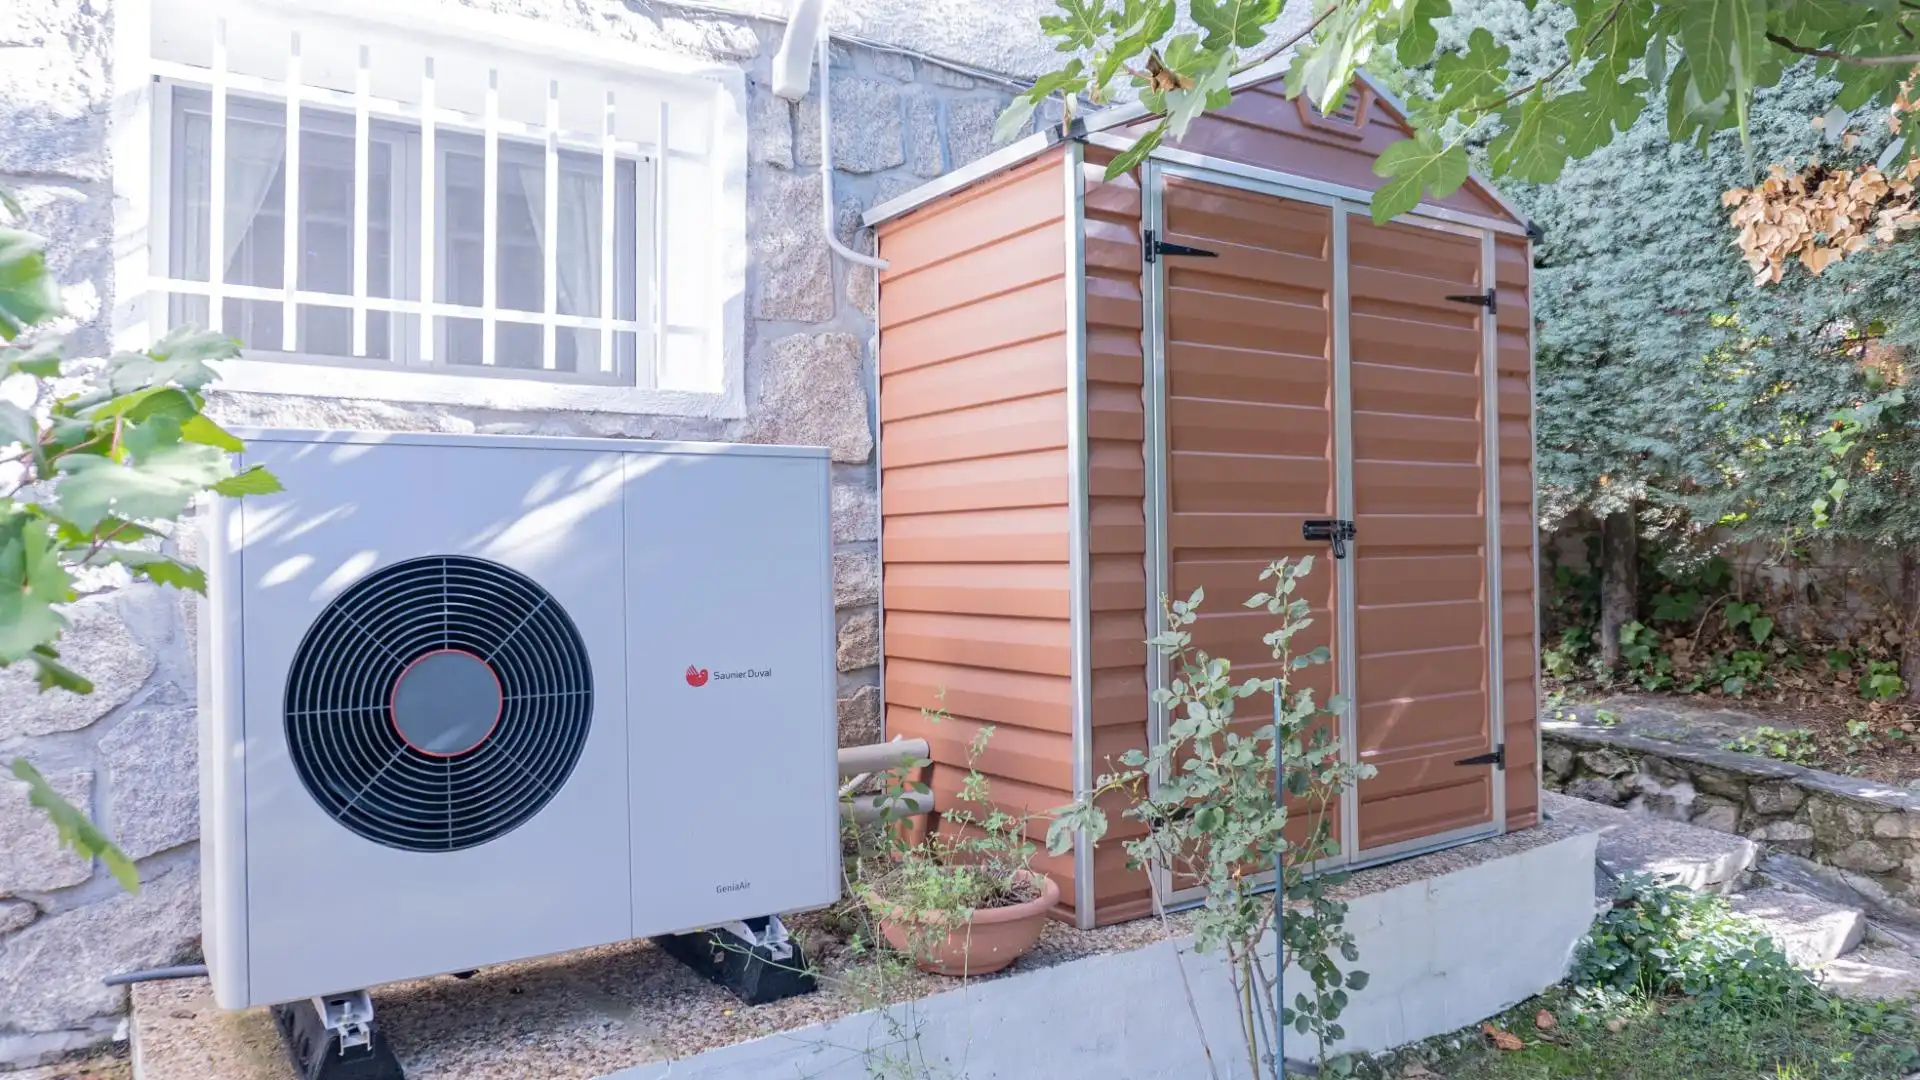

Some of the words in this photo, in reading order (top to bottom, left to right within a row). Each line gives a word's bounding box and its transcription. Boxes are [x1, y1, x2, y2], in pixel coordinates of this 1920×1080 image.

[713, 670, 746, 680] Saunier
[747, 668, 772, 678] Duval
[716, 881, 751, 894] GeniaAir
